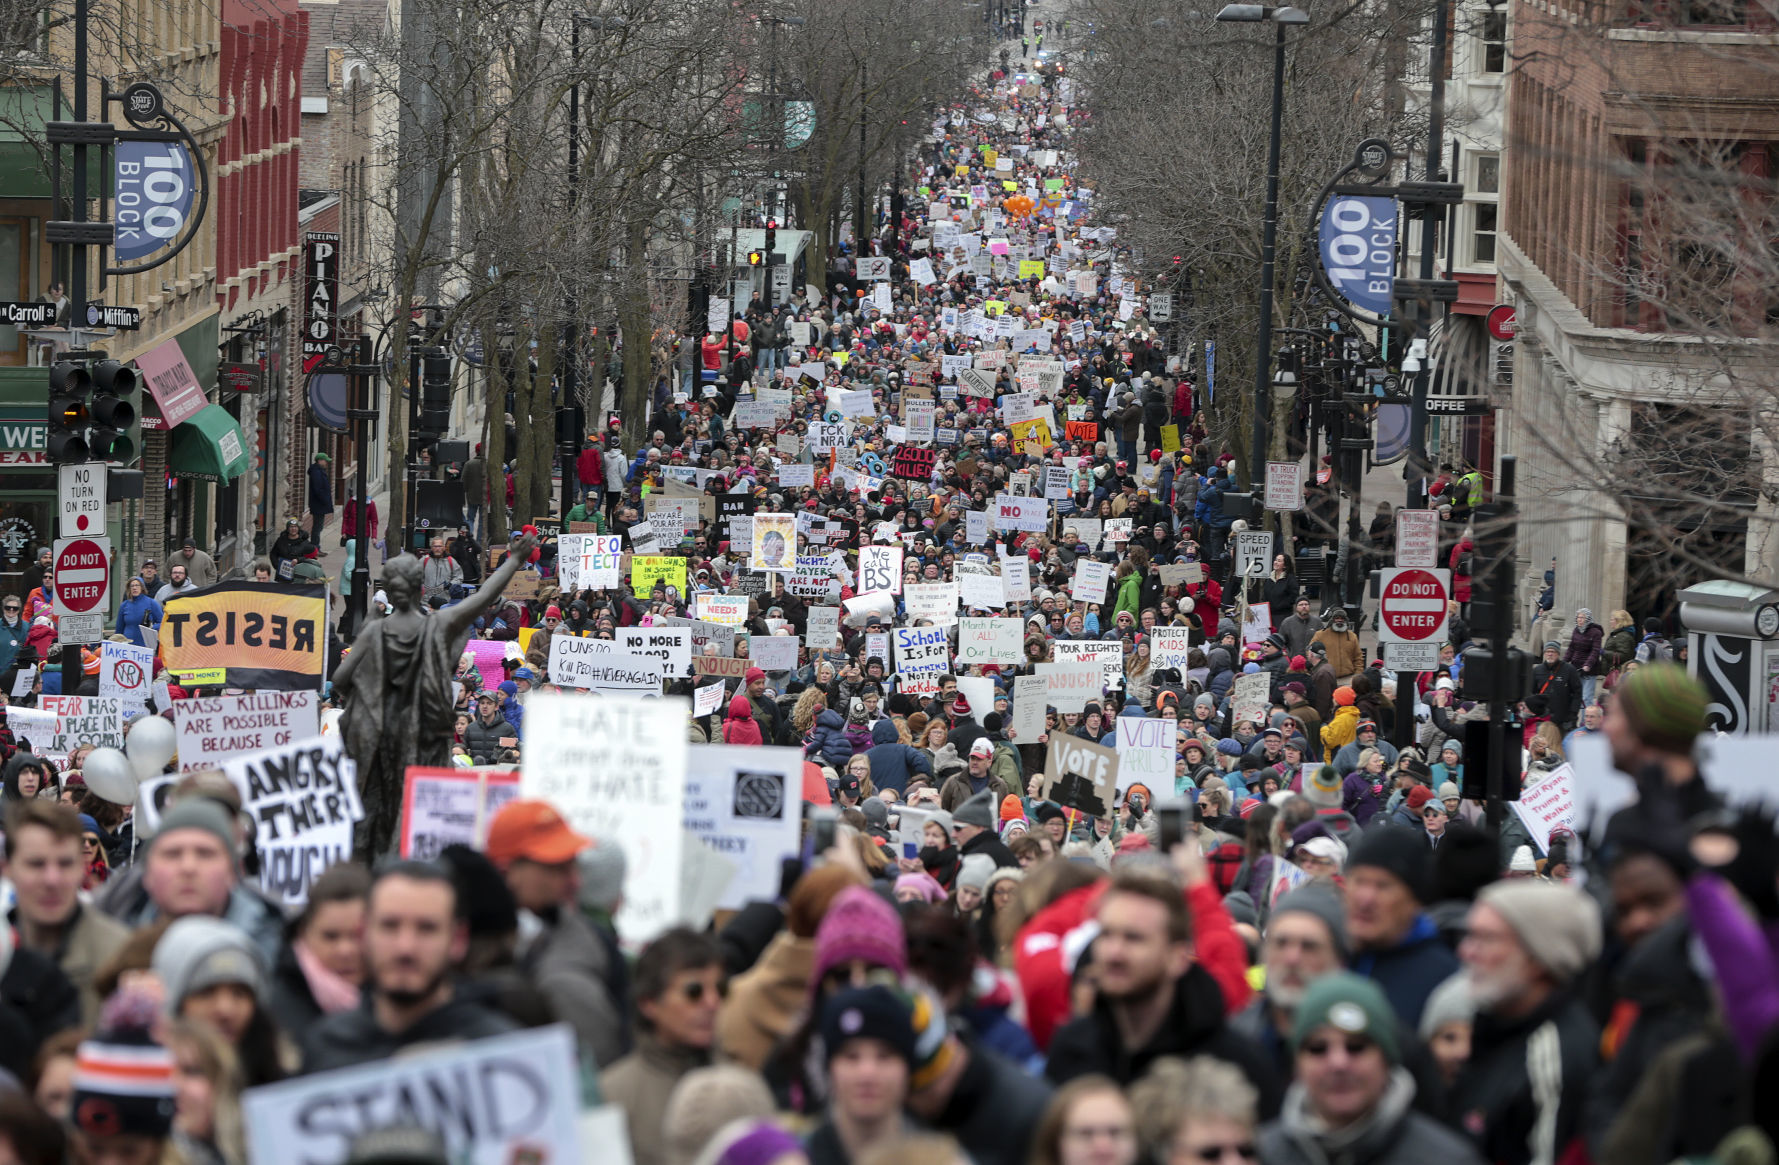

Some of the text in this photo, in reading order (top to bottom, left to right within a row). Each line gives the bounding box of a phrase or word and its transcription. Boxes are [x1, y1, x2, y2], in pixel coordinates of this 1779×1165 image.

[144, 148, 183, 238] 100
[118, 161, 140, 239] BLOCK
[1329, 200, 1369, 288] 100
[1368, 218, 1394, 293] BLOCK
[310, 242, 333, 339] PIANO
[1154, 296, 1168, 304] ONE
[8, 304, 54, 322] Carroll St
[104, 306, 139, 326] Mifflin St
[959, 384, 969, 394] 15
[821, 425, 844, 436] FCK
[1068, 424, 1096, 440] VOTE
[821, 436, 845, 446] NRA
[896, 446, 935, 462] 26000
[895, 463, 932, 477] KILLED
[1270, 465, 1297, 474] NO TRUCK
[75, 470, 90, 483] NO
[71, 487, 94, 498] TURN
[66, 500, 99, 512] ON RED
[722, 502, 744, 510] BAN
[1001, 506, 1021, 518] NO
[1414, 513, 1434, 523] TRUCK
[583, 537, 619, 554] PRO
[1240, 535, 1270, 545] SPEED
[1405, 540, 1429, 548] PARKING
[869, 548, 889, 560] We
[1243, 546, 1267, 556] LIMIT
[63, 553, 100, 566] DO NOT
[581, 554, 620, 570] TECT
[664, 557, 686, 567] GUNS
[1245, 557, 1264, 574] 15
[789, 577, 807, 585] ARE
[63, 586, 99, 600] ENTER
[1007, 590, 1029, 598] NOW!
[1392, 583, 1437, 595] DO NOT
[707, 606, 737, 614] NEEDS
[1392, 615, 1435, 627] ENTER
[1152, 628, 1186, 638] PROTECT
[558, 640, 594, 654] GUNS
[627, 636, 682, 648] NO MORE
[1084, 643, 1121, 652] RIGHTS
[1159, 640, 1185, 650] KIDS
[102, 642, 152, 664] TAKE THE
[966, 646, 1016, 659] Our Lives
[1077, 653, 1097, 662] NOT
[1166, 655, 1187, 668] NRA
[113, 662, 147, 688] NRA
[196, 671, 221, 679] MONEY
[592, 667, 662, 685] #NEVERAGAIN
[101, 683, 115, 693] OUT
[1239, 680, 1268, 692] SILENCE
[43, 697, 82, 717] FEAR
[88, 698, 118, 715] HAS
[176, 692, 308, 717] MASS KILLINGS
[66, 717, 99, 734] PLACE
[104, 715, 117, 731] IN
[184, 712, 288, 735] ARE POSSIBLE
[560, 710, 655, 742] HATE
[1122, 719, 1174, 748] VOTE
[202, 730, 292, 752] BECAUSE OF
[1054, 740, 1110, 786] VOTE
[1124, 750, 1168, 772] APRIL 3
[244, 747, 345, 801] ANGRY
[1521, 774, 1567, 806] Paul Ryan,
[1532, 787, 1570, 814] Trump &
[1542, 801, 1573, 822] Walker
